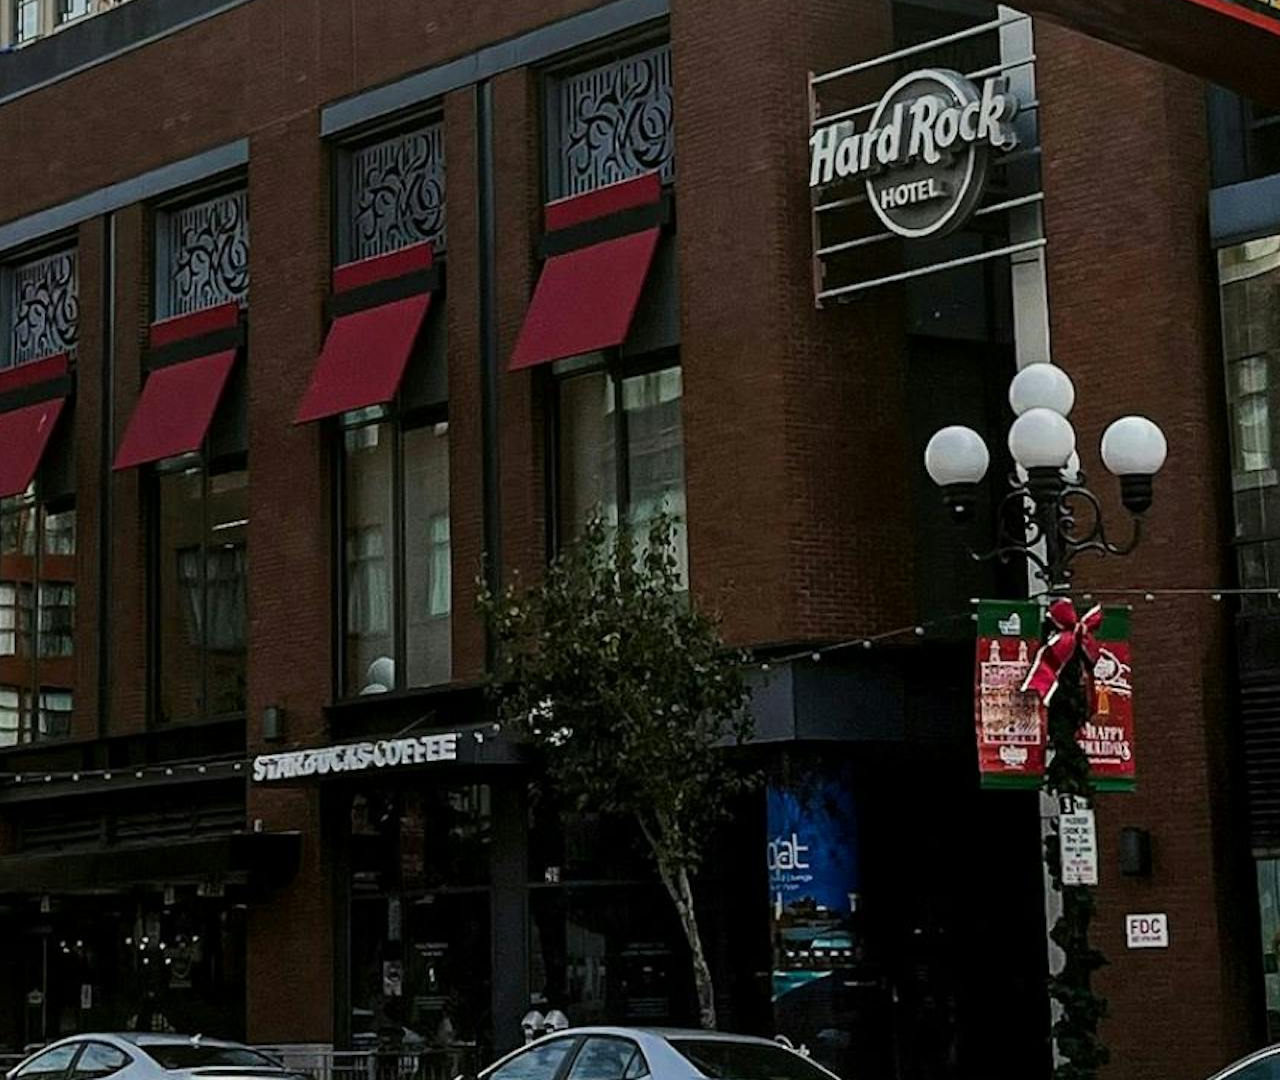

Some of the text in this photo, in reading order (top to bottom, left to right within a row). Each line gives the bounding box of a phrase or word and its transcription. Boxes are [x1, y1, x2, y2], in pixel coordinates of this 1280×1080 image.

[809, 78, 1007, 187] Hard Rock
[880, 177, 938, 211] HOTEL
[253, 732, 458, 781] STARBUCKS COFFEE
[1130, 918, 1161, 934] FDC
